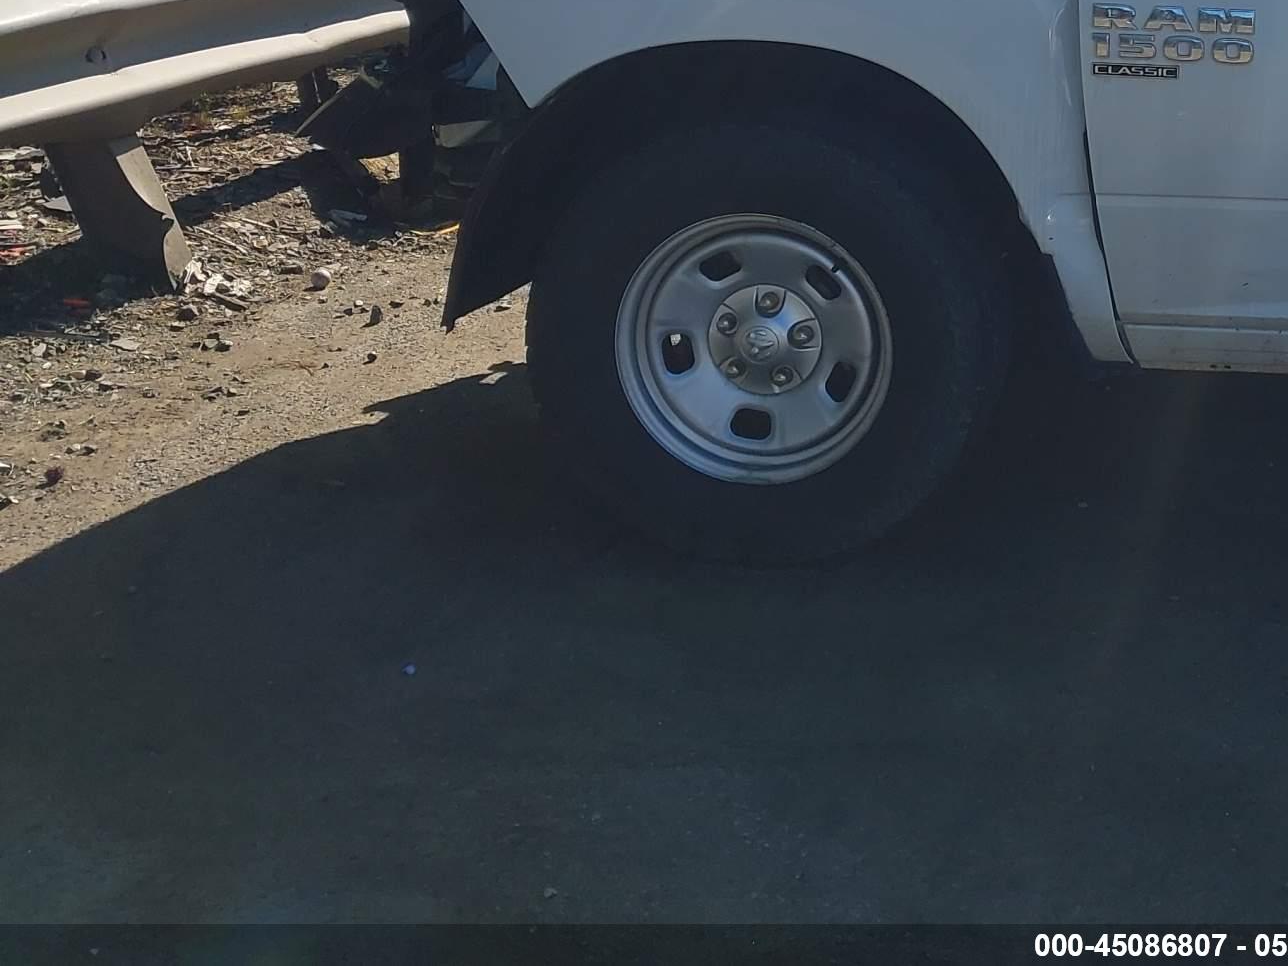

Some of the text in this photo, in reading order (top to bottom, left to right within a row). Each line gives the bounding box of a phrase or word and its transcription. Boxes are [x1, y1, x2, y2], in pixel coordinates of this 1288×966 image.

[1093, 2, 1255, 34] RAM
[1093, 32, 1254, 63] 1500
[1094, 65, 1177, 78] CLASSIC
